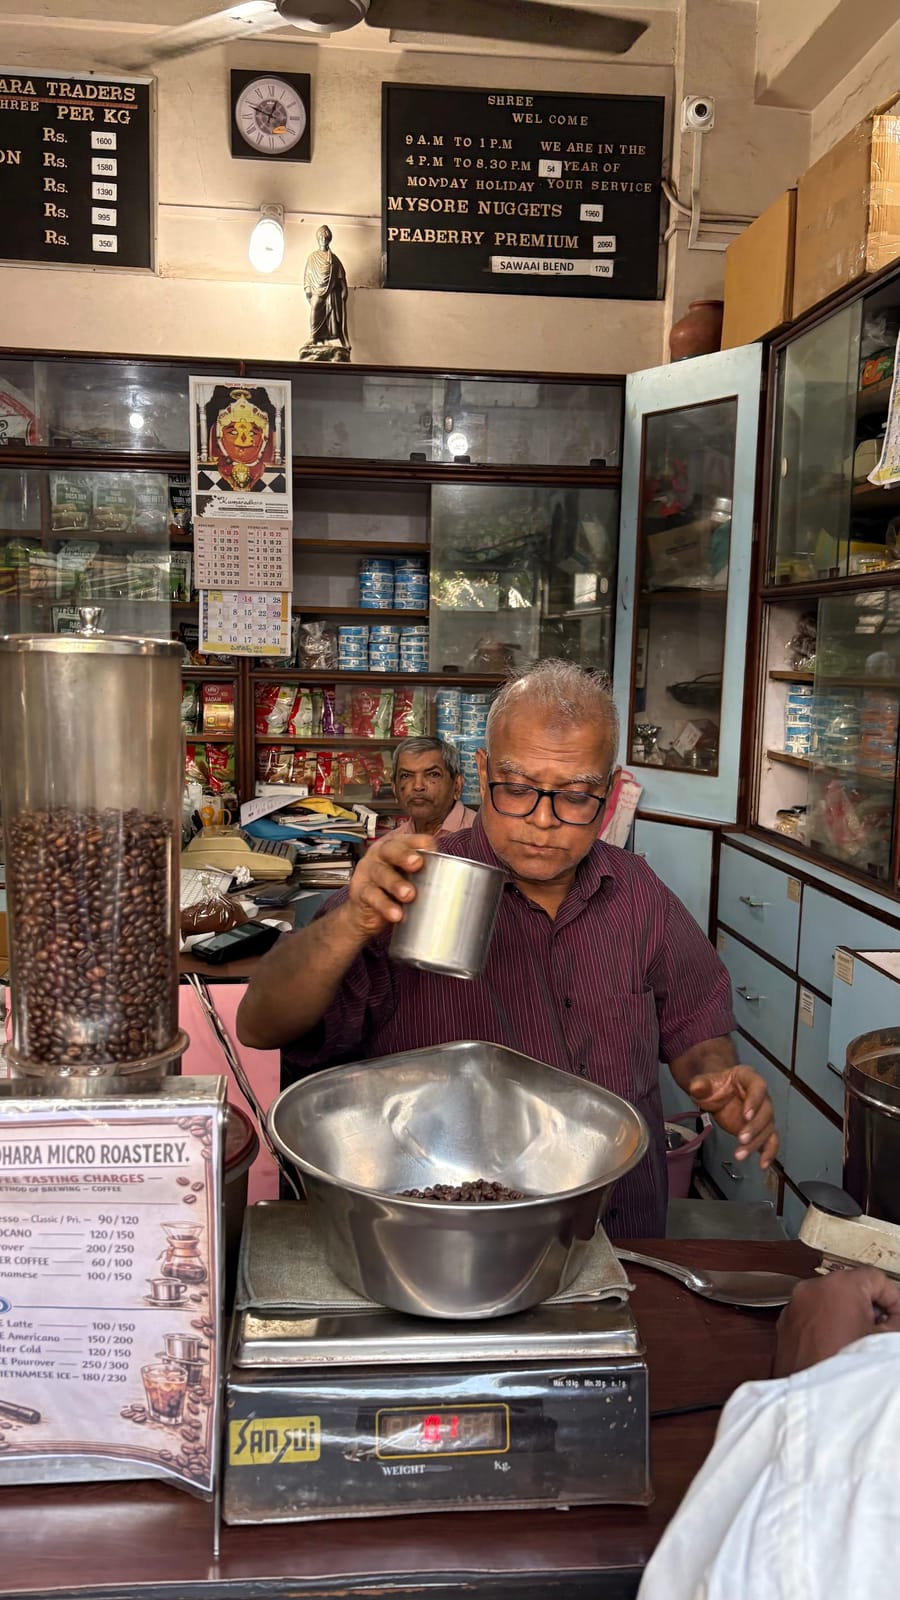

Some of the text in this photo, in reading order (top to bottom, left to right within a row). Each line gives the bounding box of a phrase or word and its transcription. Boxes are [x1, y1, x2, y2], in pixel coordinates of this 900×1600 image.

[46, 81, 136, 102] TRADERS
[488, 95, 534, 108] SHREE
[0, 100, 131, 125] HREE PER KG
[512, 112, 589, 126] WEL COME
[42, 127, 112, 145] Rs. 1600
[406, 134, 646, 156] 9 A.M TO 1 P.M WE ARE IN THE
[42, 152, 68, 168] Rs.
[96, 164, 113, 172] 1580
[406, 154, 414, 166] 4
[418, 156, 444, 168] P.M
[454, 157, 472, 169] TO
[476, 158, 508, 170] 8.30
[510, 159, 532, 172] P.M
[564, 160, 598, 172] YEAR
[603, 162, 620, 173] OF
[43, 177, 113, 196] Rs. 1390
[407, 176, 652, 193] MONDAY HOLIDAY YOUR SERVICE
[44, 202, 111, 222] Rs. 995
[387, 196, 600, 218] MYSORE NUGGETS 1960
[44, 230, 70, 246] Rs.
[387, 228, 484, 246] PEABERRY
[494, 232, 579, 249] PREMIUM
[500, 260, 610, 273] SAWAAI BLEND 1700
[0, 1142, 190, 1166] HARA MICRO ROASTERY.
[24, 1174, 80, 1184] TASTING
[83, 1174, 144, 1184] CHARGES
[14, 1256, 50, 1266] COFFEE
[7, 1320, 33, 1328] Latte
[8, 1332, 60, 1342] Americano
[19, 1345, 42, 1354] Cold
[11, 1358, 56, 1367] Pourover
[382, 1464, 426, 1476] WEIGHT
